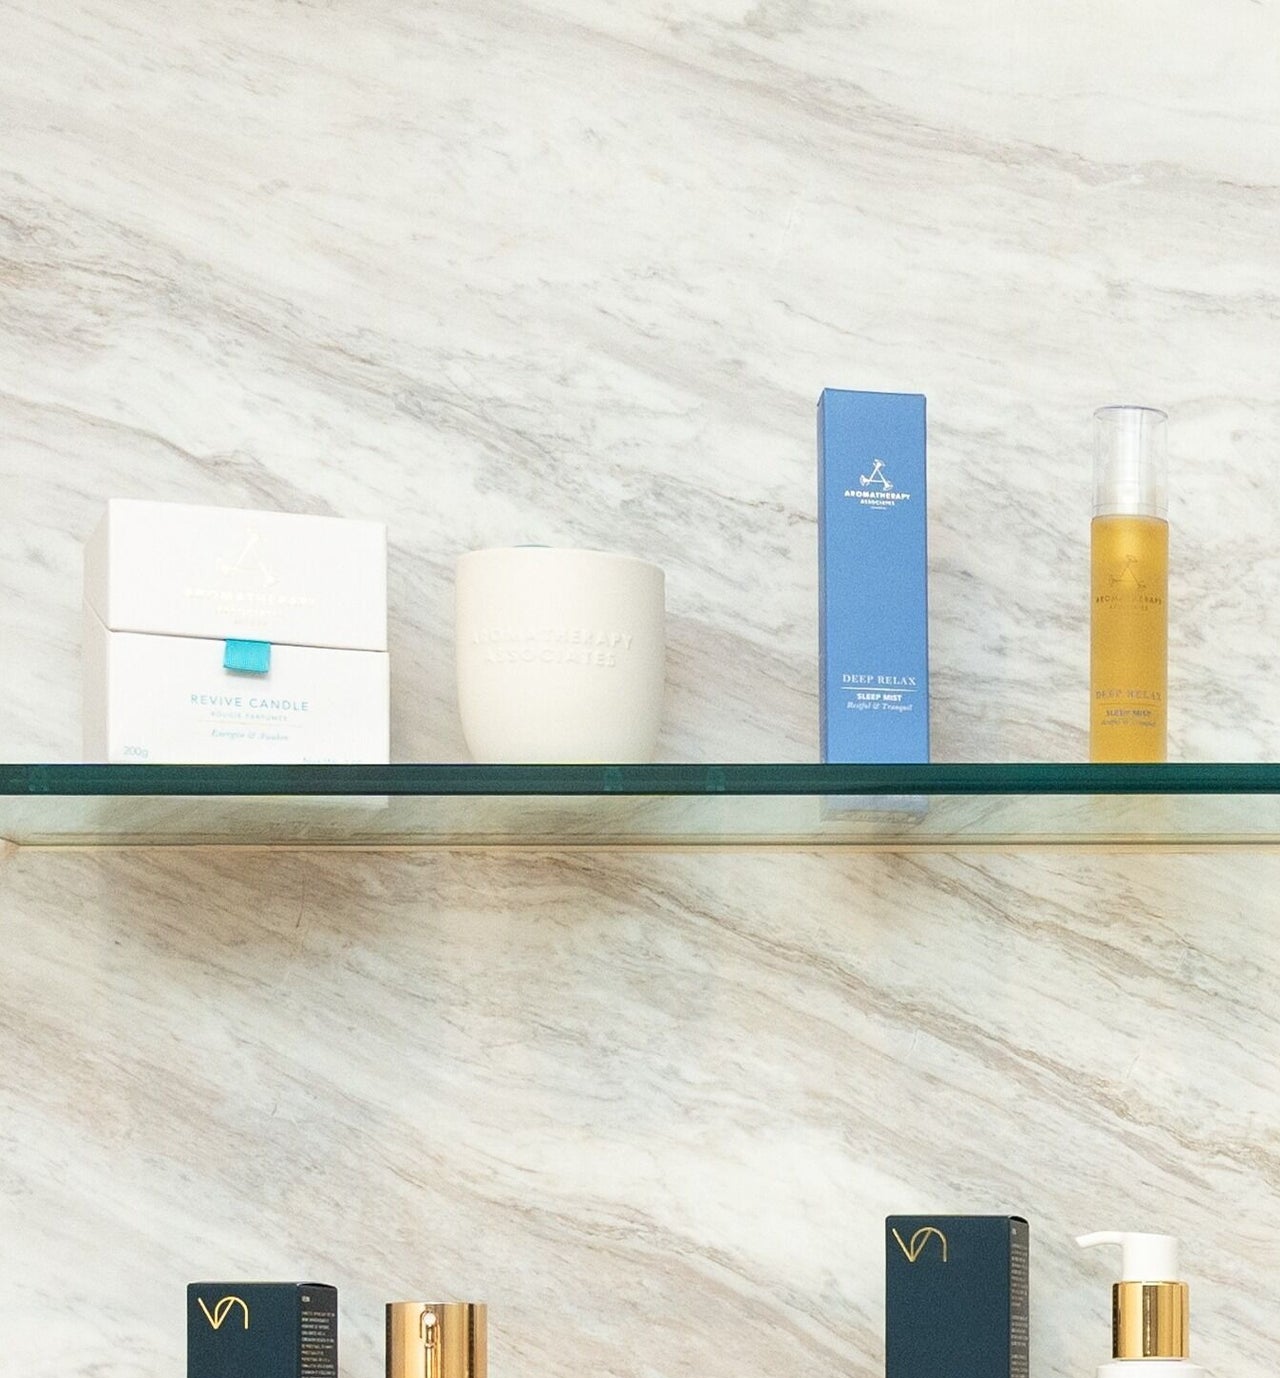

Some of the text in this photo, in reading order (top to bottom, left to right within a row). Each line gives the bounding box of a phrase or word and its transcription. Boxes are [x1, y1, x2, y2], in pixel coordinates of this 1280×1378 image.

[844, 490, 911, 500] AROMATHERAPY
[842, 673, 917, 686] DEEP RELAX
[190, 693, 309, 712] REVIVE CANDLE
[123, 745, 149, 759] 200g
